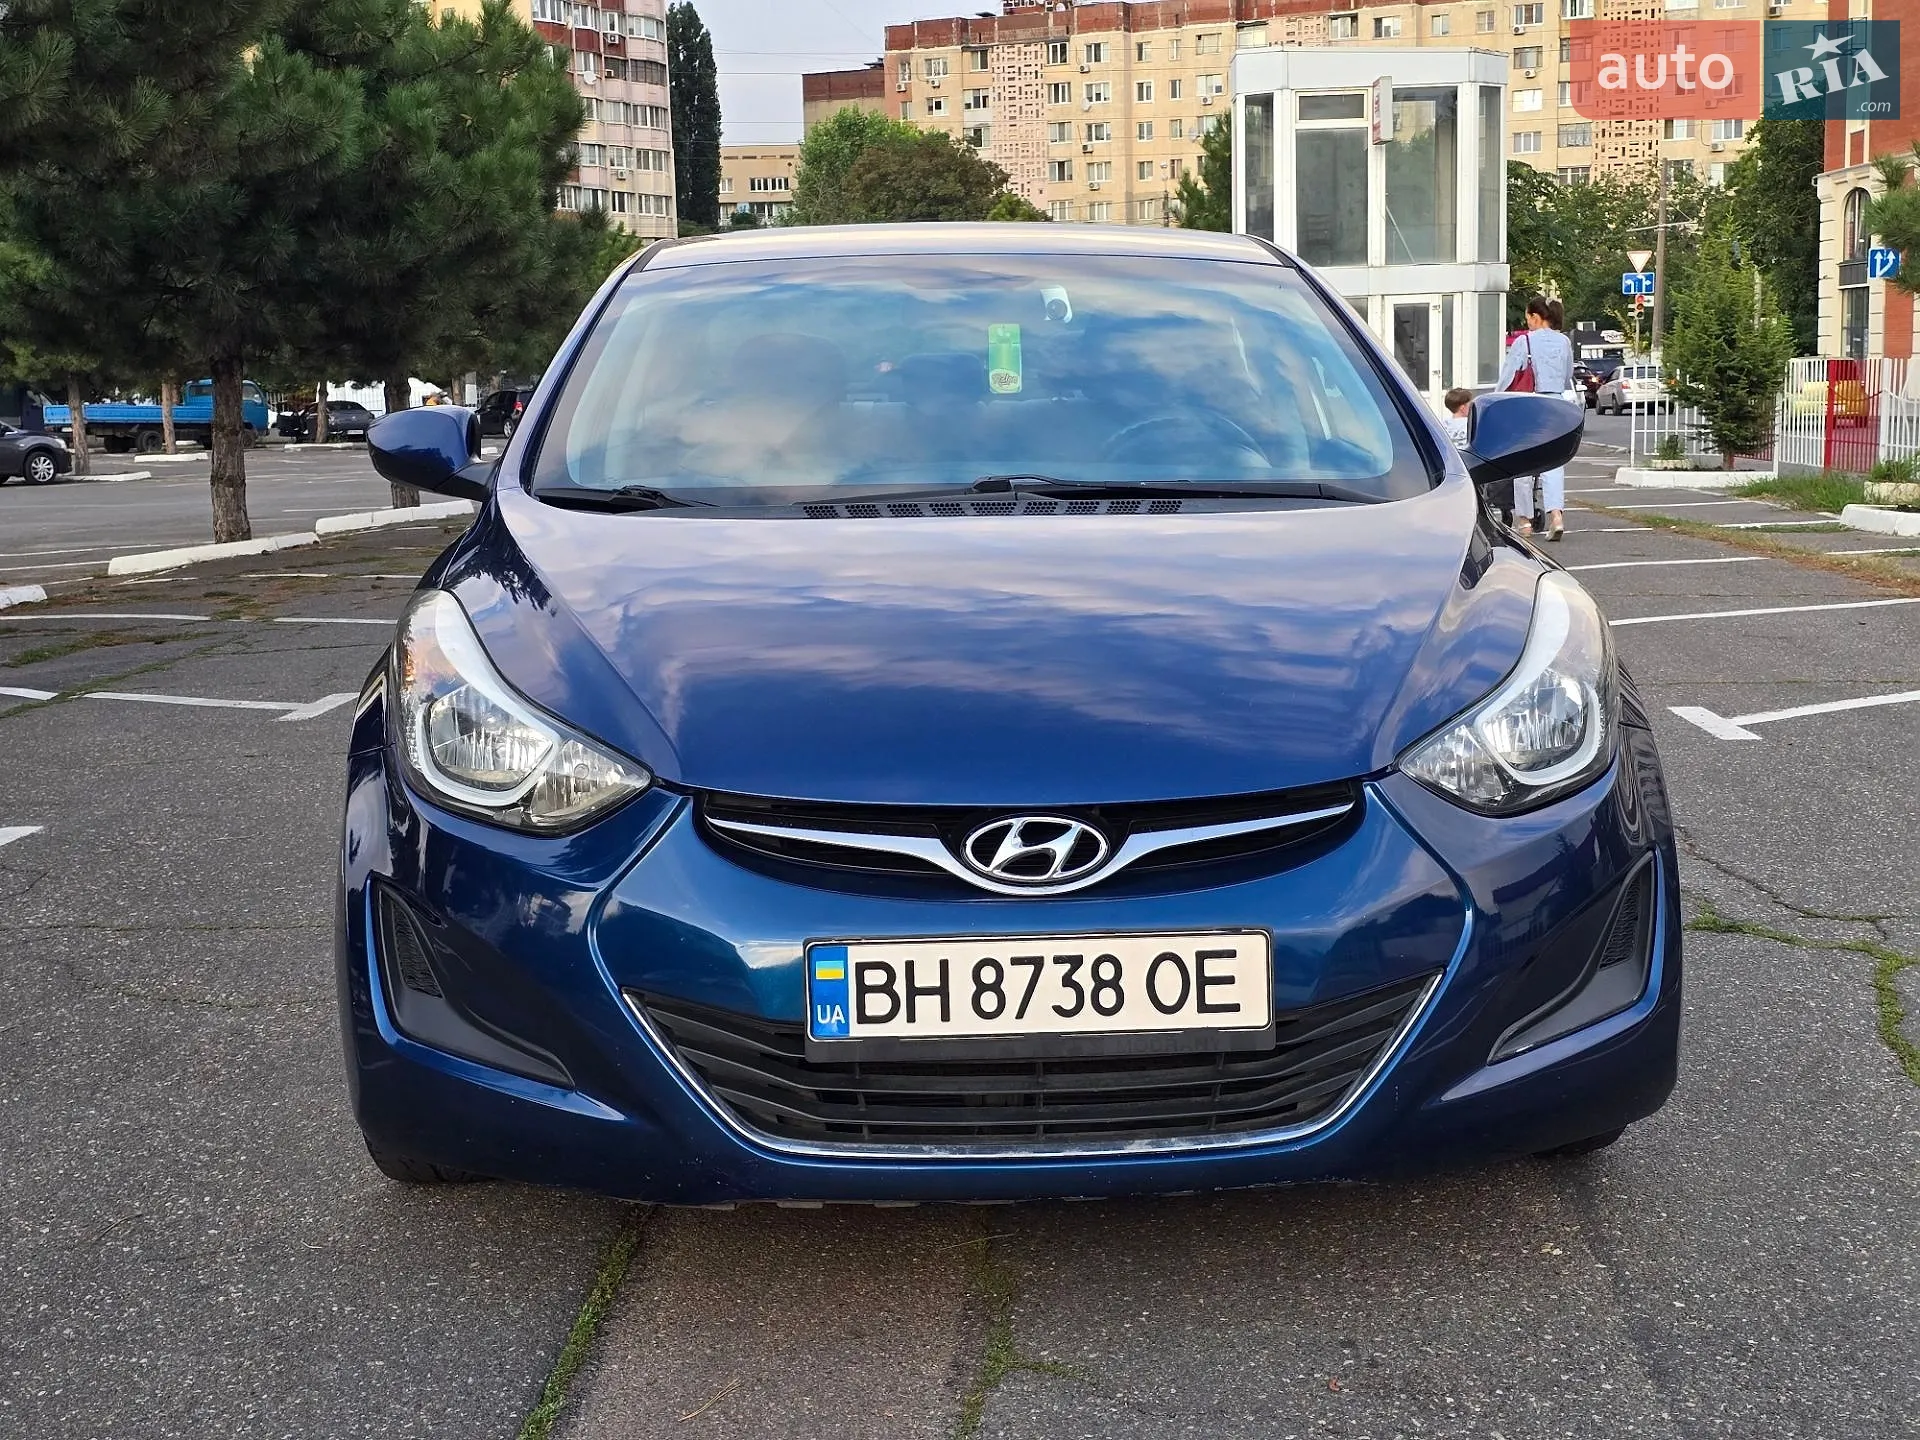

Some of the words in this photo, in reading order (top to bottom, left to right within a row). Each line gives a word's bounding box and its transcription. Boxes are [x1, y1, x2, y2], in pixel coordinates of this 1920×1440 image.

[855, 958, 951, 1024] BH
[971, 954, 1125, 1020] 8738
[1145, 949, 1241, 1015] OE
[816, 1004, 846, 1025] UA
